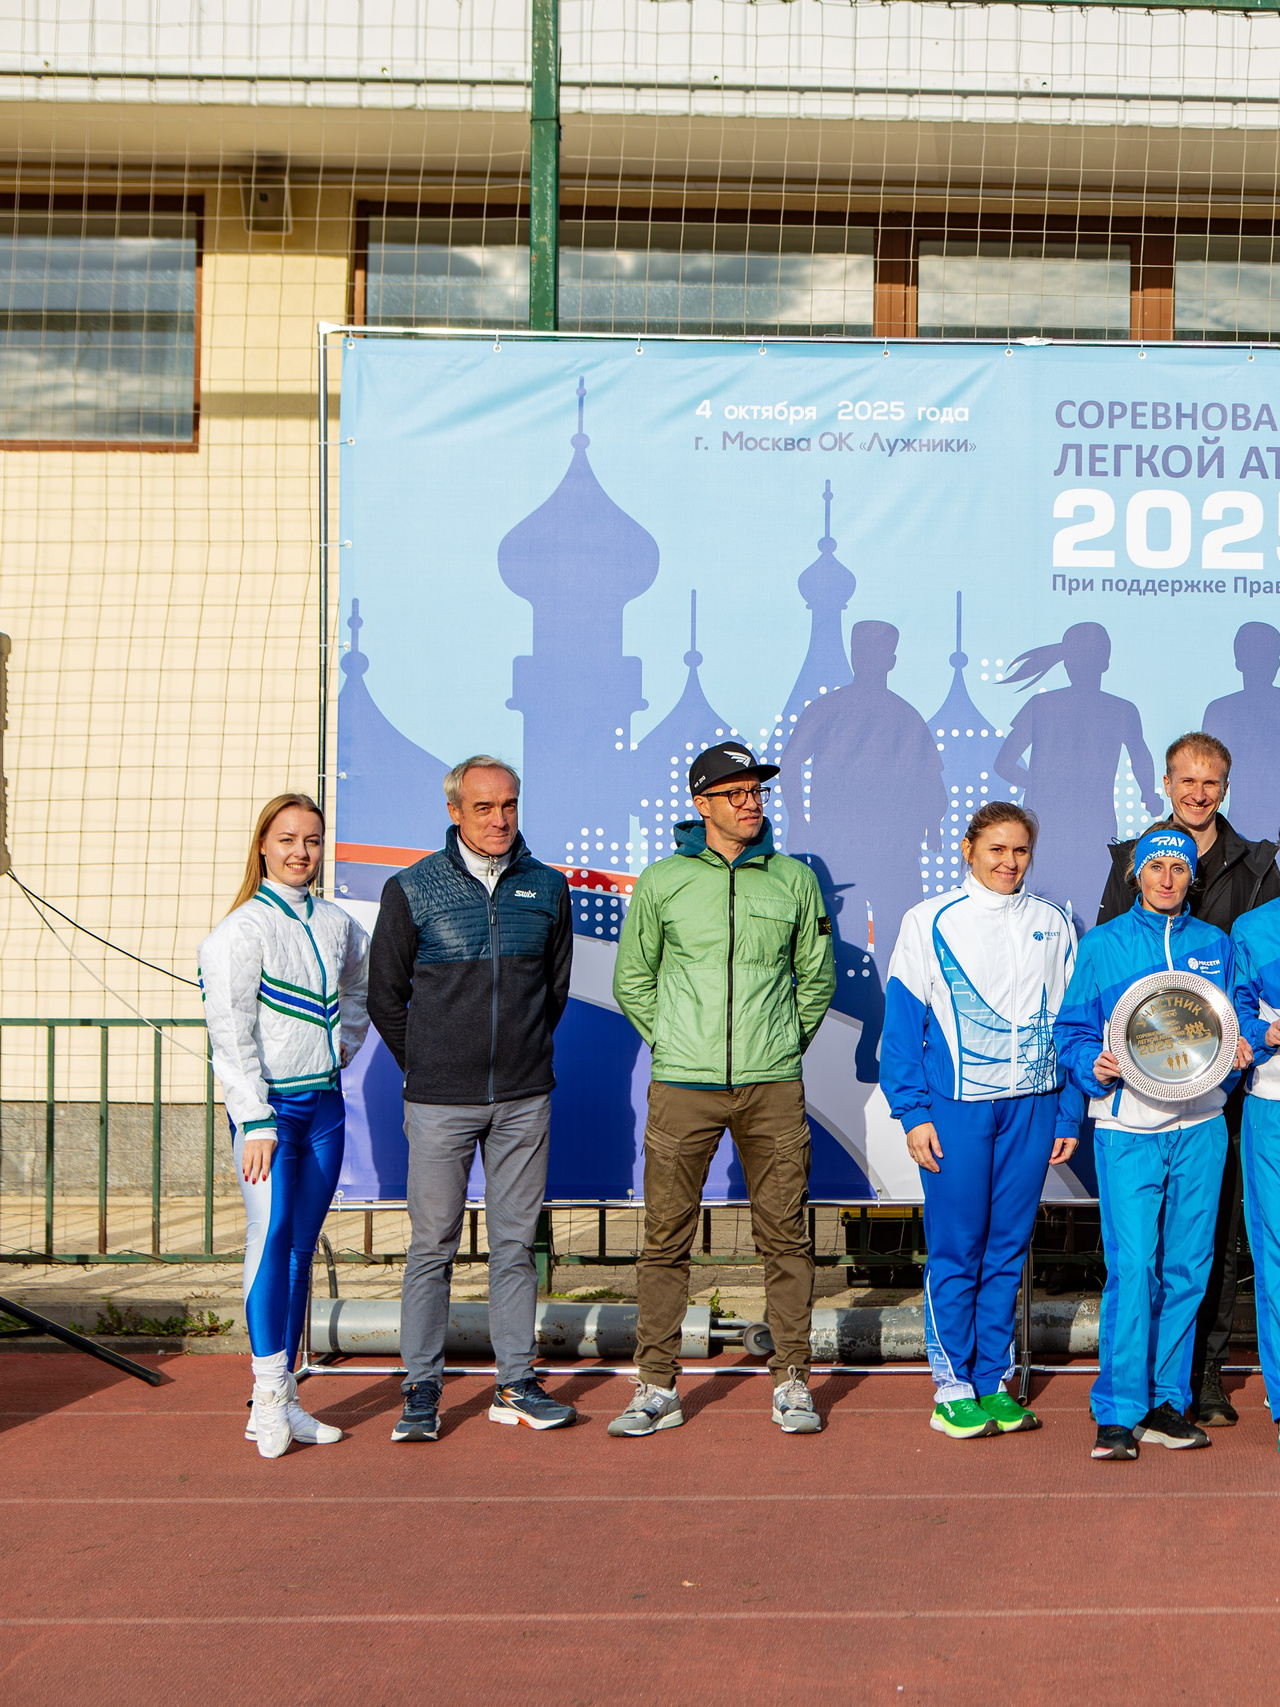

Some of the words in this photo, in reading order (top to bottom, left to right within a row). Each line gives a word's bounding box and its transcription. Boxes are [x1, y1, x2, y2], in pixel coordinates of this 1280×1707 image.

[695, 400, 712, 419] 4
[723, 401, 817, 425] октября
[837, 400, 905, 421] 2025
[917, 406, 969, 424] года
[695, 436, 709, 451] г.
[721, 431, 812, 451] Москва
[818, 432, 855, 452] ОК
[859, 433, 977, 458] «Лужники»
[1053, 436, 1225, 479] ЛЕГКОЙ
[1052, 574, 1094, 597] При
[1101, 579, 1227, 597] поддержке
[1136, 996, 1203, 1027] УЧАСТНИК
[1138, 1039, 1175, 1056] 2025
